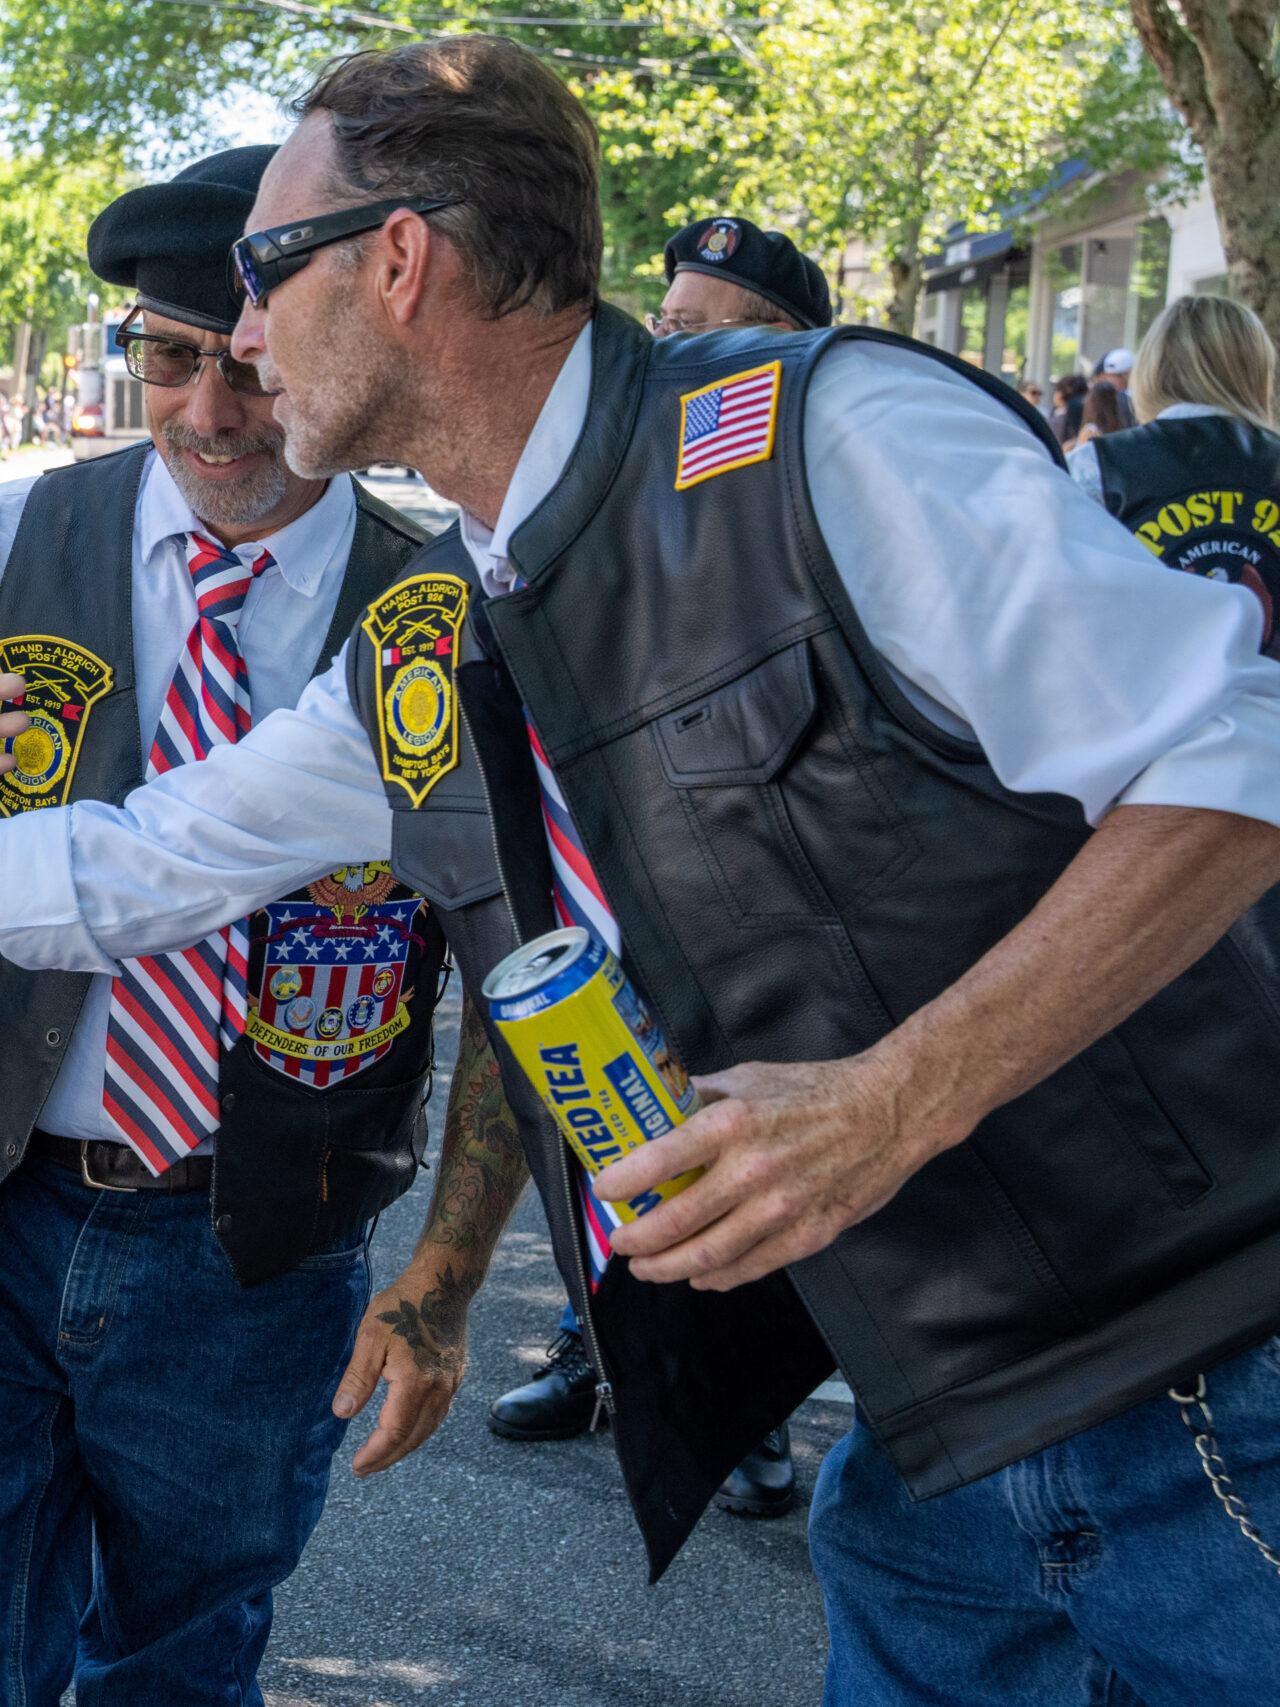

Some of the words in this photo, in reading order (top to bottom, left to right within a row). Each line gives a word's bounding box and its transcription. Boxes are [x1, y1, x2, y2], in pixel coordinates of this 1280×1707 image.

[1134, 491, 1243, 557] POST
[1178, 541, 1262, 568] AMERICAN
[381, 589, 411, 614] HAND
[419, 582, 460, 598] ALDRICH
[397, 594, 424, 612] POST
[426, 594, 444, 603] 924
[10, 643, 43, 656] HAND
[53, 645, 100, 677] ALDRICH
[419, 642, 435, 654] 1919
[28, 653, 57, 664] POST
[61, 658, 79, 673] 924
[393, 667, 443, 701] AMERICAN
[44, 699, 62, 710] 1919
[402, 727, 438, 747] LEGION
[393, 752, 428, 771] HAMPTON
[430, 743, 450, 763] BAYS
[401, 767, 417, 780] NEW
[421, 764, 442, 778] YORK
[2, 795, 19, 810] NEW
[35, 795, 57, 807] BAYS
[250, 1022, 308, 1054] DEFENDERS
[314, 1046, 328, 1056] OF
[334, 1046, 354, 1056] OUR
[358, 1021, 404, 1052] FREEDOM
[539, 1043, 592, 1105] TEA
[597, 1089, 614, 1110] TEA
[620, 1068, 670, 1139] IGINAL
[610, 1113, 629, 1138] ICED
